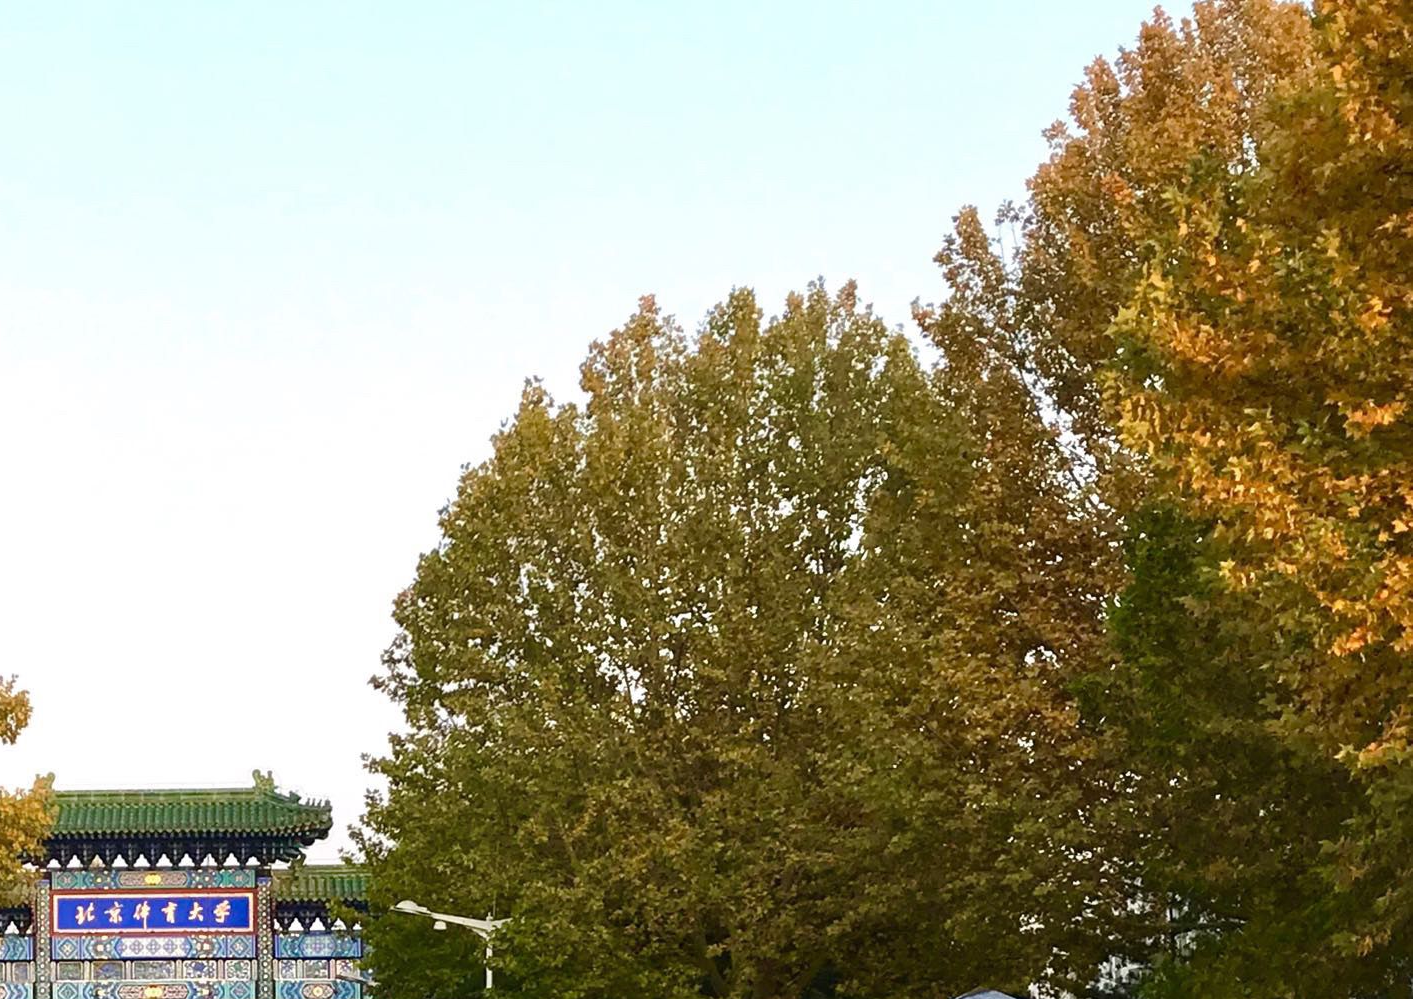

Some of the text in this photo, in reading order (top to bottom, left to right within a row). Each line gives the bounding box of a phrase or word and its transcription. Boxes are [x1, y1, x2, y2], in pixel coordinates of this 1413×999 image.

[75, 900, 231, 930] 北京体育大学
